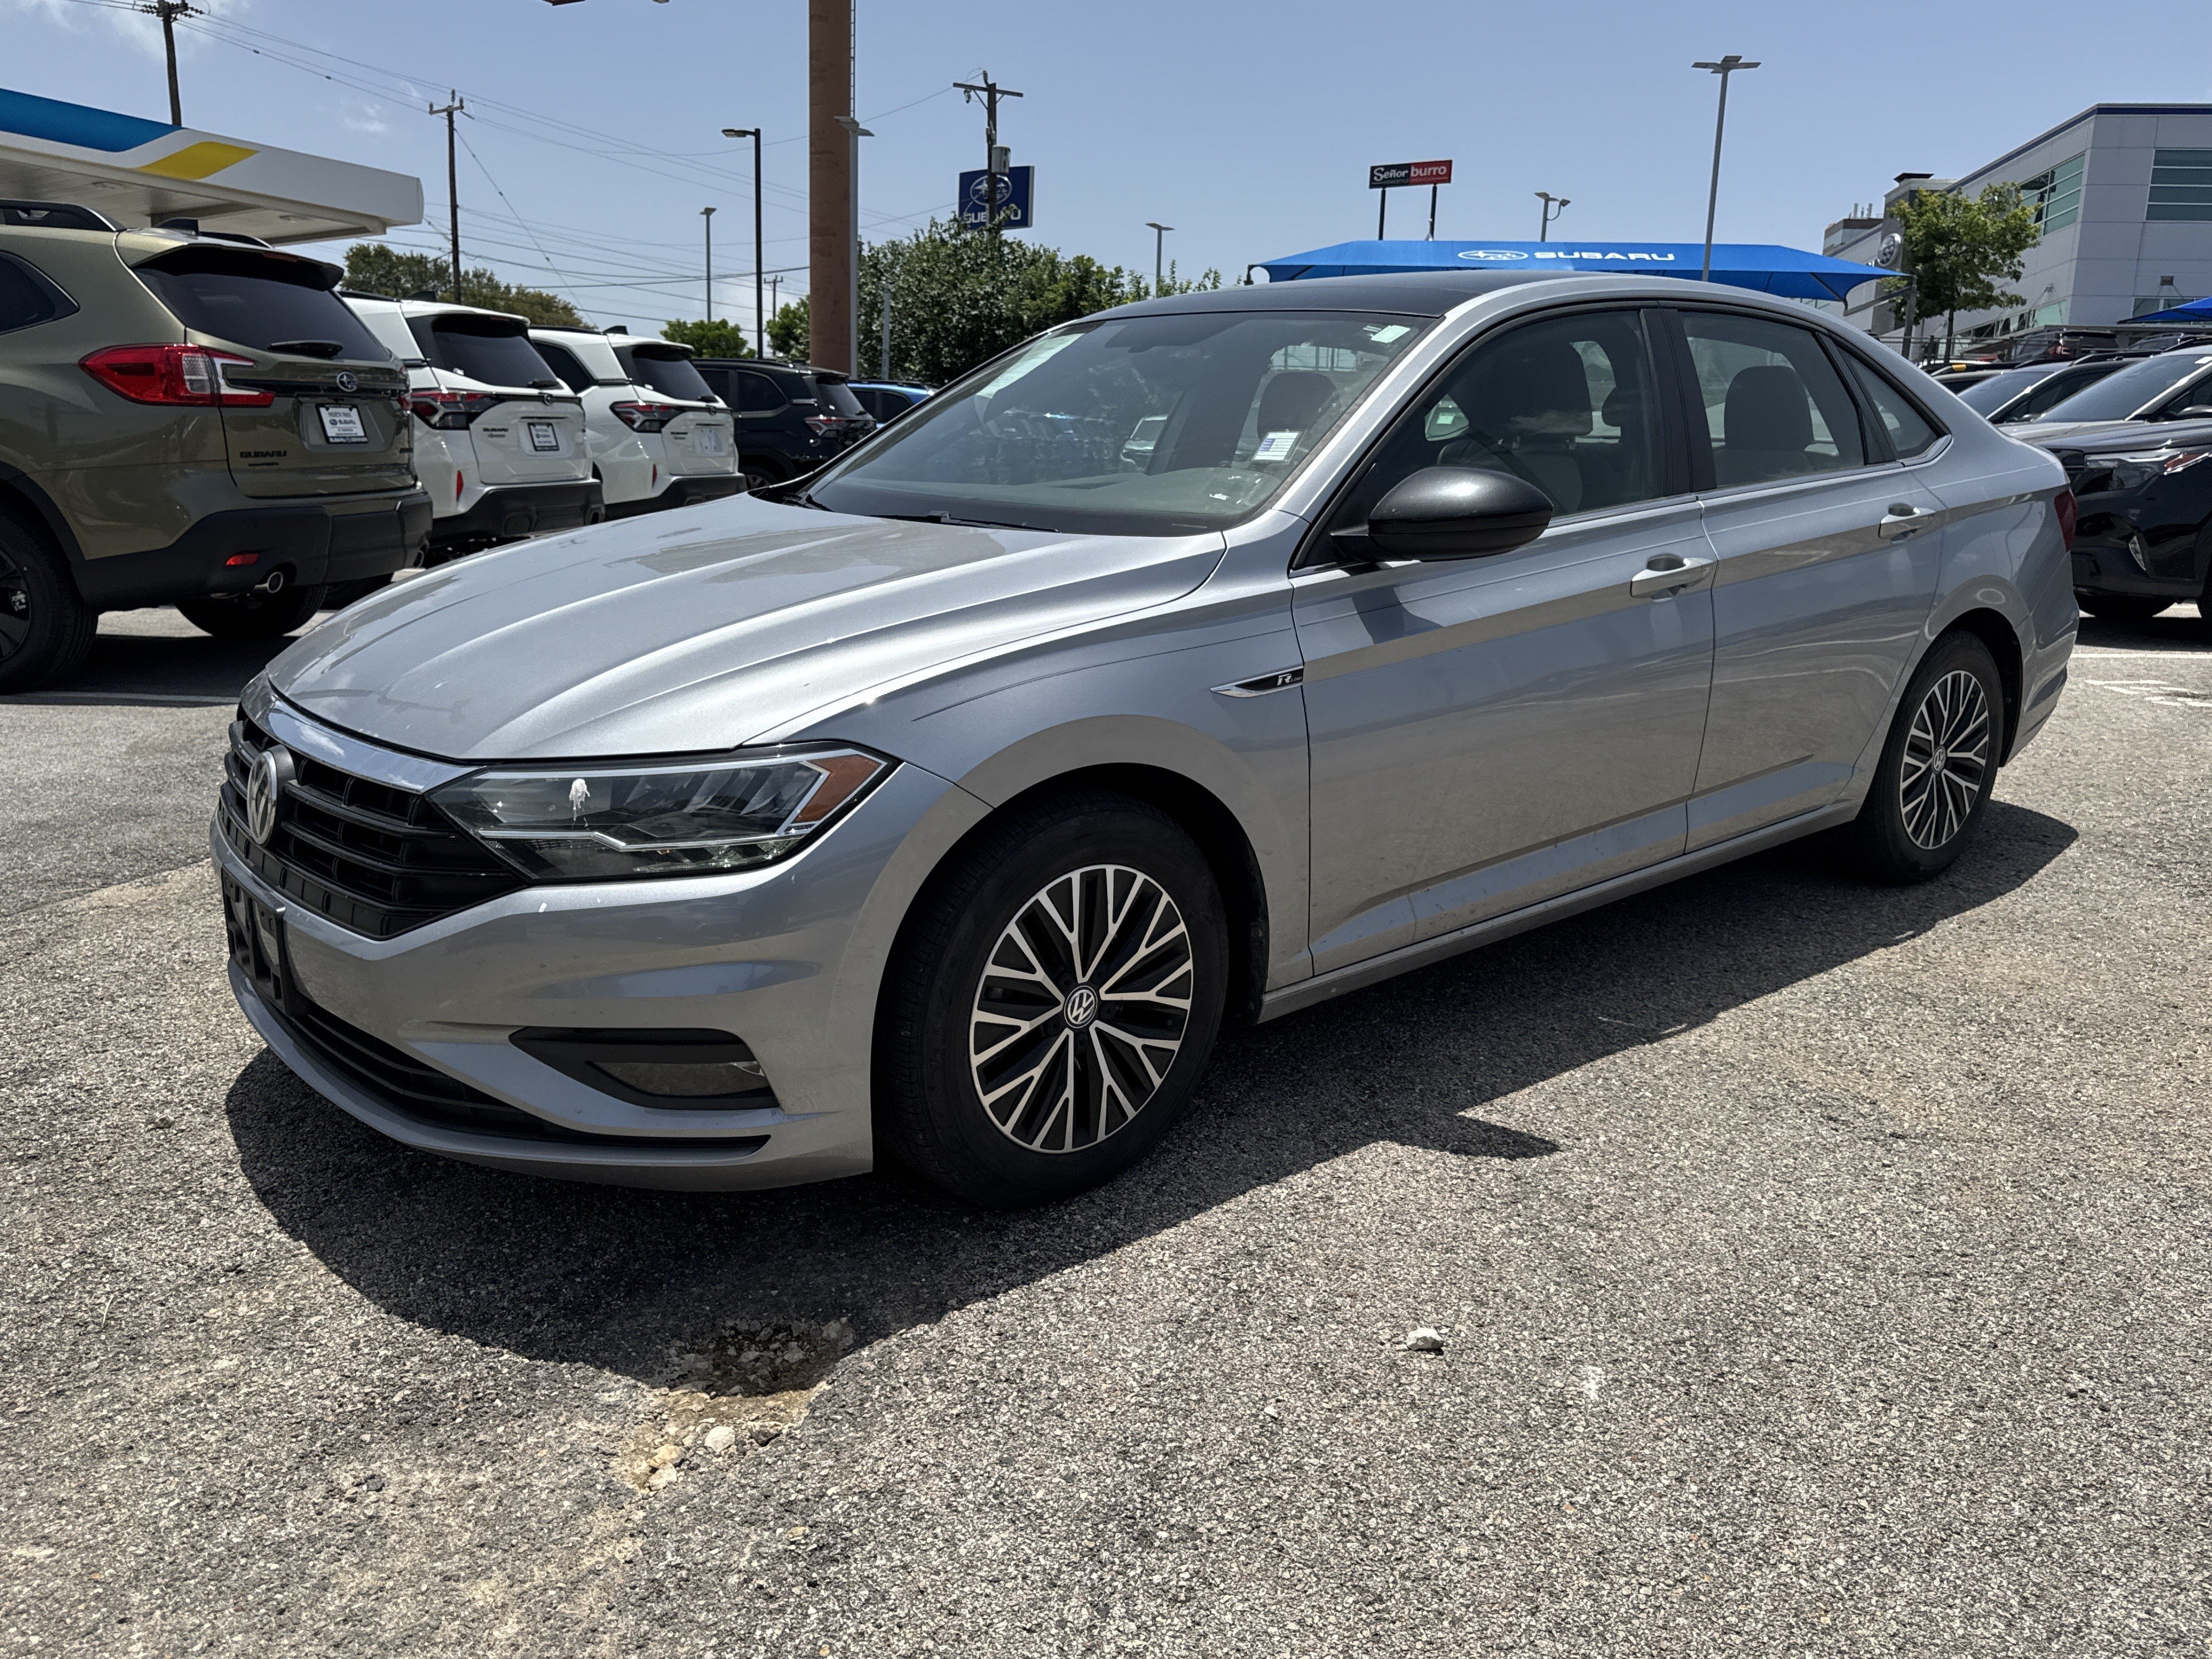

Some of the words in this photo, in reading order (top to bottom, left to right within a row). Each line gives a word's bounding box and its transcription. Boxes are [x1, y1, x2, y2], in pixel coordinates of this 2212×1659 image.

[1373, 167, 1409, 182] Señor
[1410, 166, 1447, 177] burro
[1534, 251, 1675, 261] SUBARU
[1067, 989, 1096, 1025] VW
